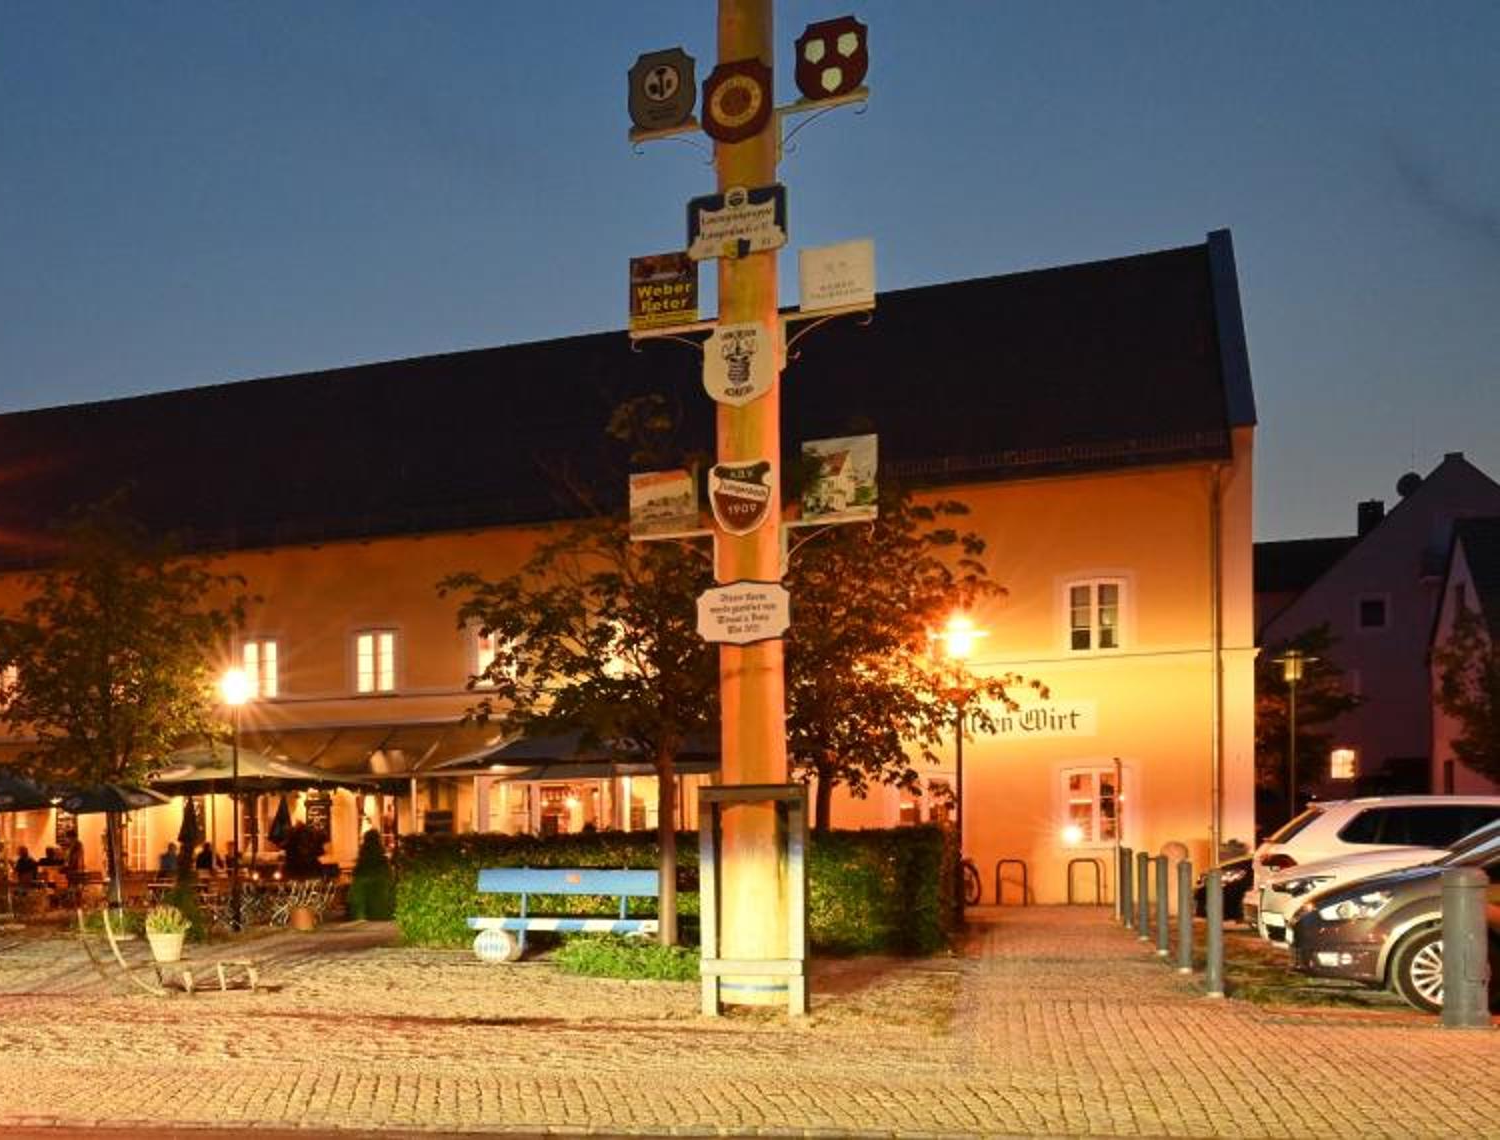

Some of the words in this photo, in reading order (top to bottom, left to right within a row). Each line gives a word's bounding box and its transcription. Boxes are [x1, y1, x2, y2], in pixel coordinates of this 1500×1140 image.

[637, 283, 692, 299] Weber
[642, 298, 688, 313] Peter
[728, 503, 757, 516] 1909
[1019, 707, 1080, 732] Wirt
